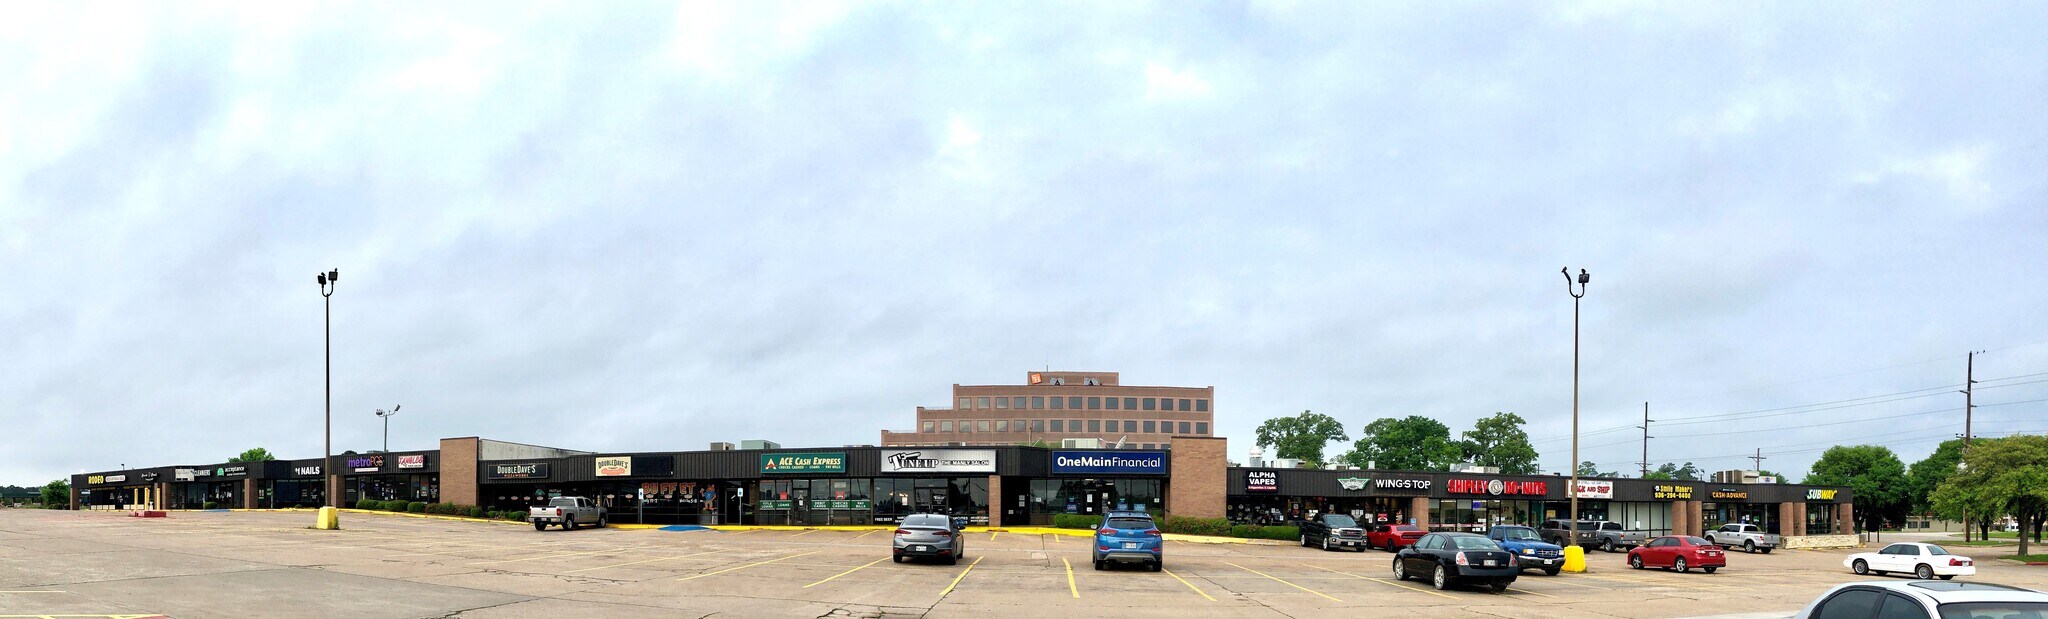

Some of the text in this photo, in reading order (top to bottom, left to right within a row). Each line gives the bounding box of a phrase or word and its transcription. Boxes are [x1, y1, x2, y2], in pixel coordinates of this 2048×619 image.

[779, 457, 793, 465] ACE
[888, 452, 921, 470] TUNE
[924, 459, 939, 468] UP
[1057, 456, 1160, 468] OneMainFinancial
[88, 475, 104, 484] RODEO
[1447, 479, 1547, 495] SHIPLEY DO-NUTS
[1712, 491, 1747, 499] CASH ADVANCE
[1807, 489, 1837, 500] SUBWAY
